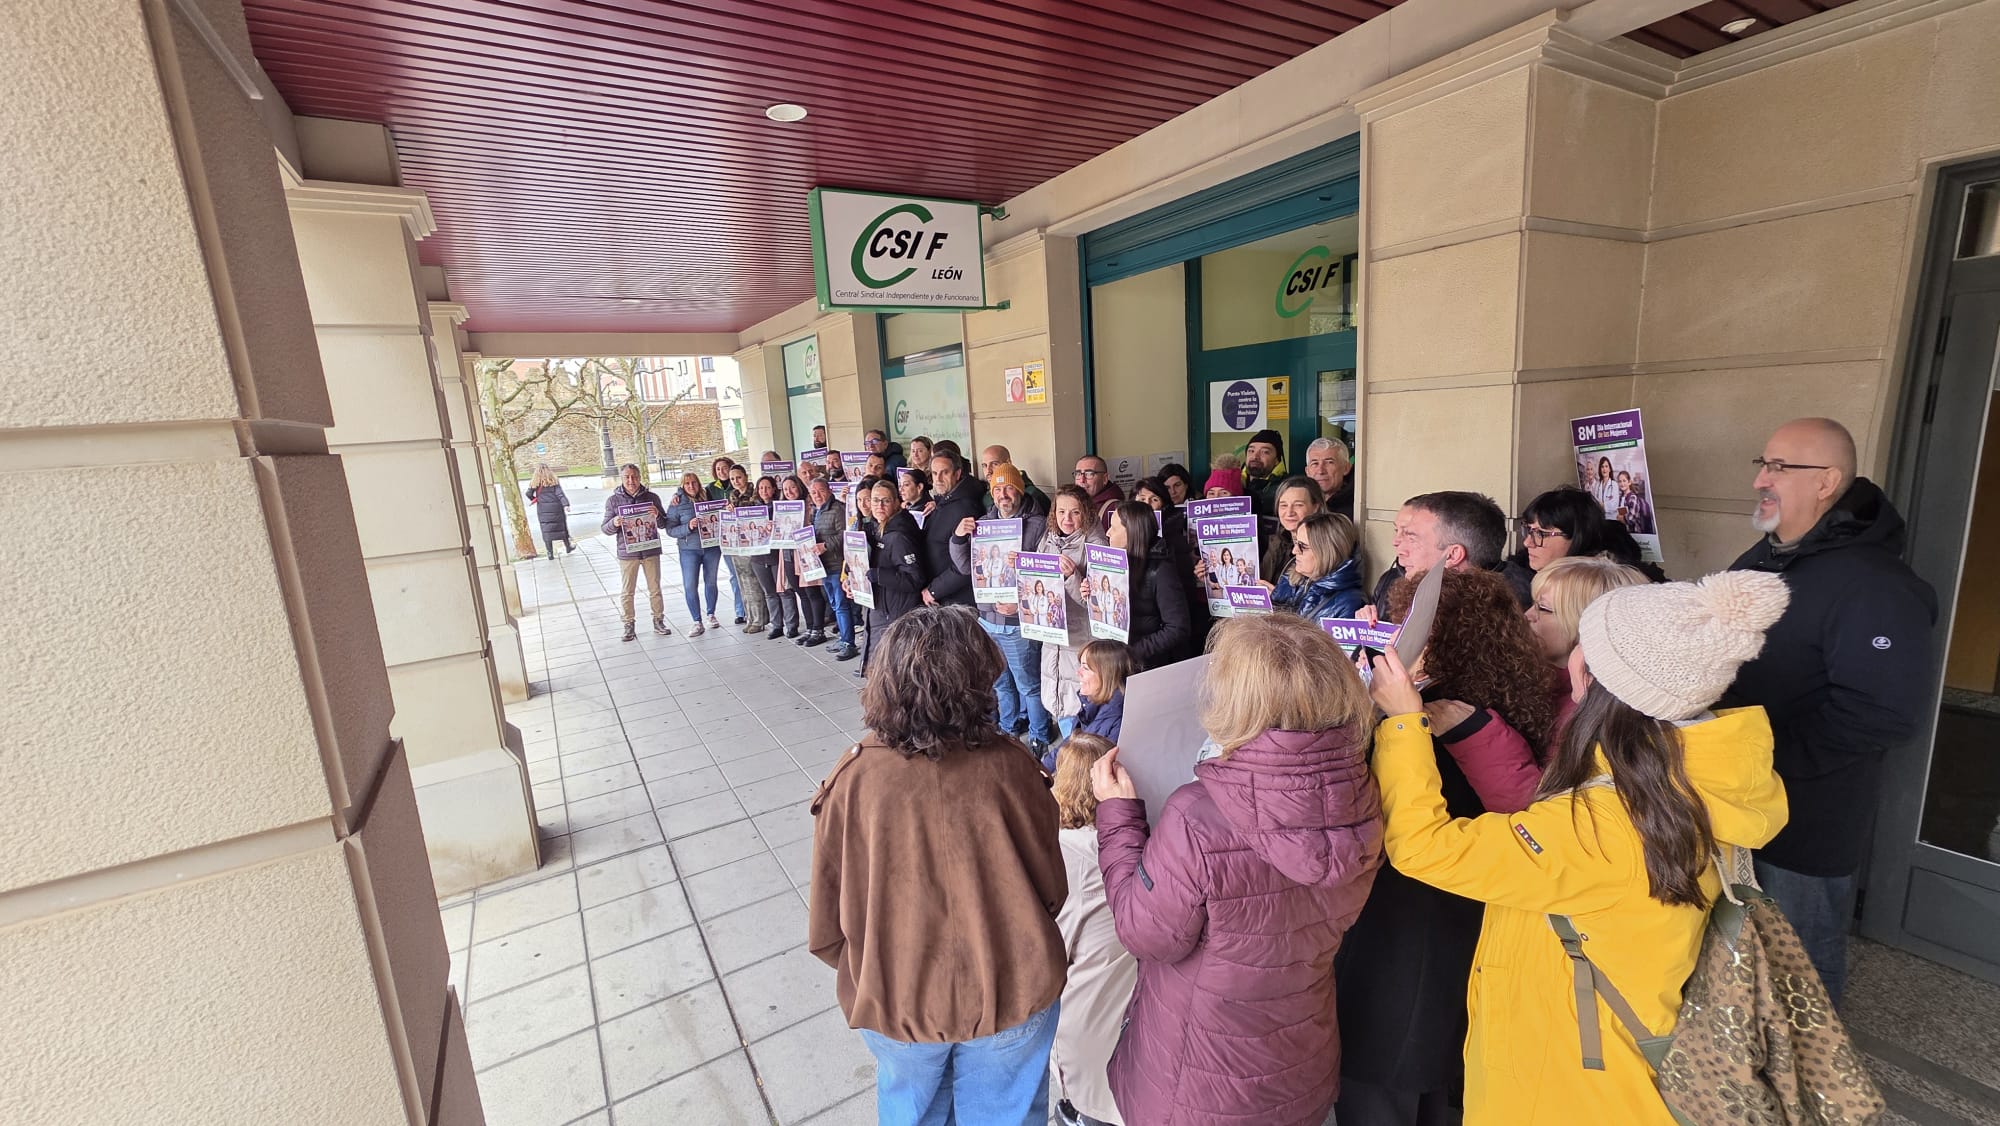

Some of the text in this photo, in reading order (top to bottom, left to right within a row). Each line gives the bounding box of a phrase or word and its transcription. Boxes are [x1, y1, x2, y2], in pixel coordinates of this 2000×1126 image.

[932, 266, 962, 280] LEÓN
[835, 290, 859, 298] Central
[860, 290, 884, 298] Sindical
[887, 291, 930, 300] Independiente
[945, 294, 980, 302] Funcionarios
[1578, 425, 1596, 440] 8M
[1604, 420, 1632, 430] Internacional
[1194, 504, 1212, 514] 8M
[977, 526, 990, 535] 8M
[1203, 524, 1219, 535] 8M
[1020, 557, 1034, 567] 8M
[1091, 550, 1102, 562] 8M
[1231, 592, 1245, 604] 8M
[1332, 626, 1357, 640] 8M
